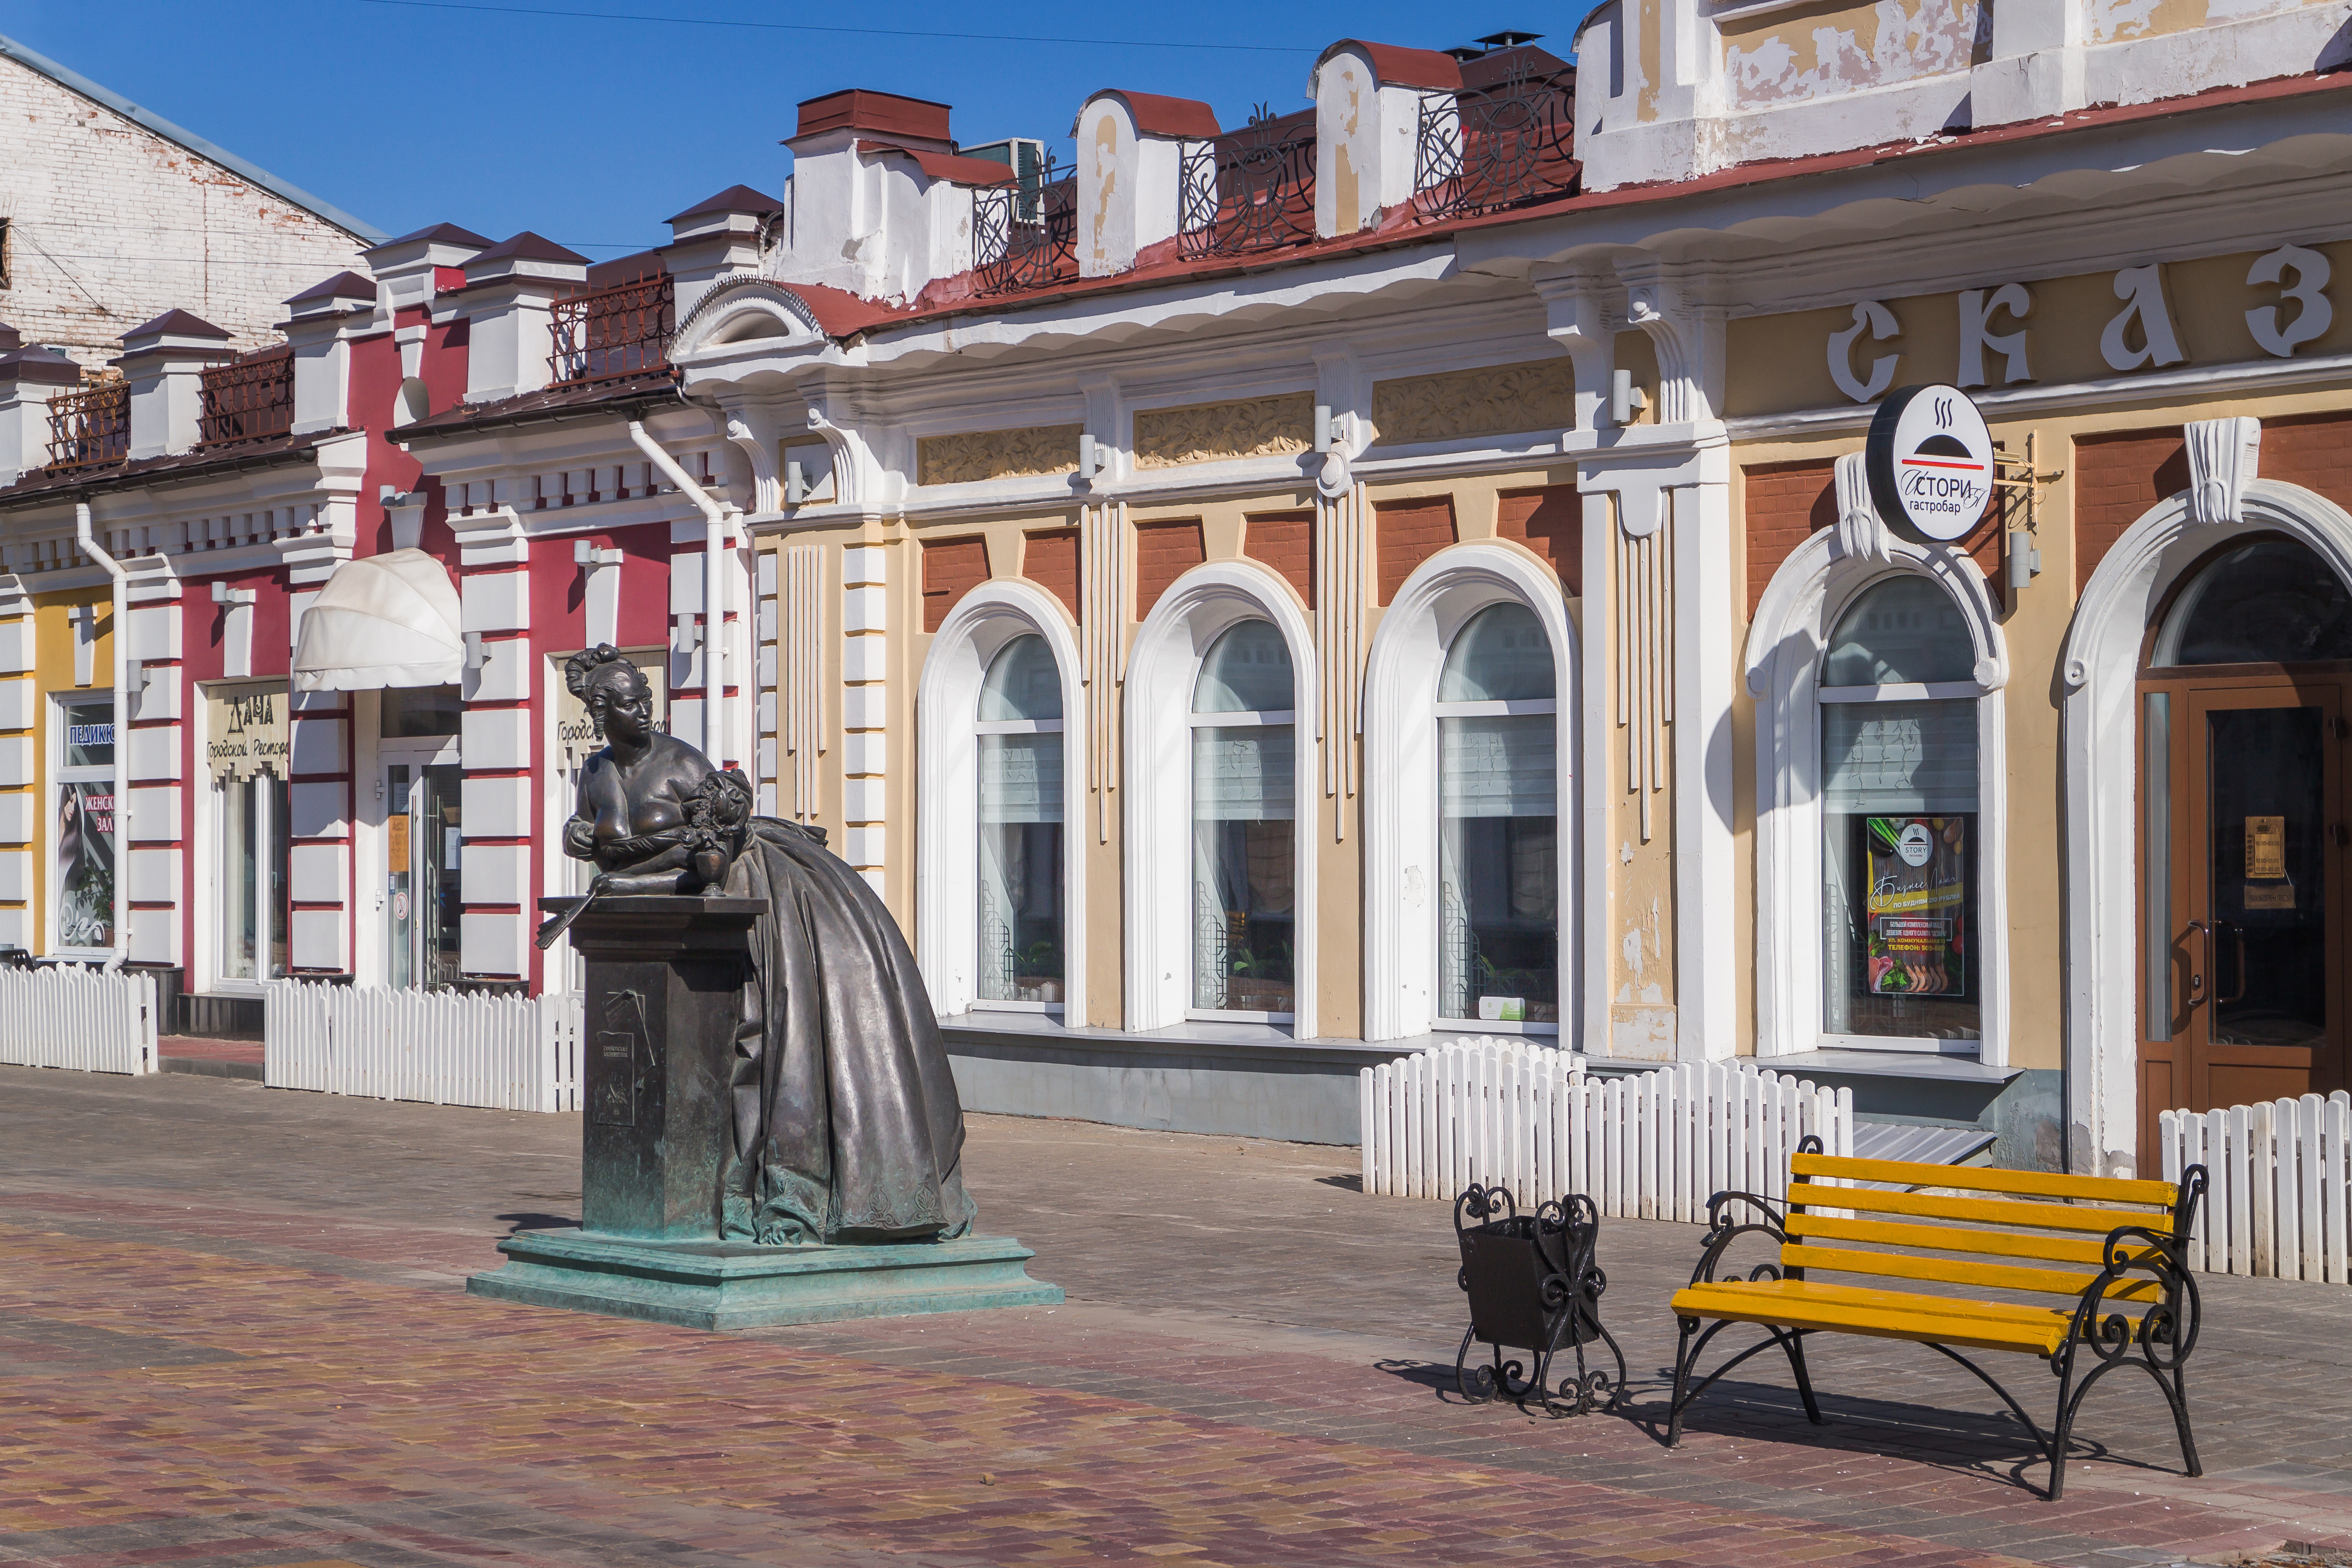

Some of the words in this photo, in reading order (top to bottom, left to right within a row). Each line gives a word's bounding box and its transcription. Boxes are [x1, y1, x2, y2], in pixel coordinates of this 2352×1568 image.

[1910, 500, 1961, 516] гастробар
[228, 694, 274, 738] ДАЧА
[69, 723, 114, 746] ПЕДИКЮ
[558, 719, 593, 746] Городс
[207, 740, 248, 764] Городской
[254, 739, 289, 760] Рестора
[85, 794, 114, 811] ЖЕНСК
[97, 816, 113, 832] ЗАЛ
[1903, 898, 1927, 907] БУДНЯМ
[1939, 893, 1960, 902] РУБЛЕЙ
